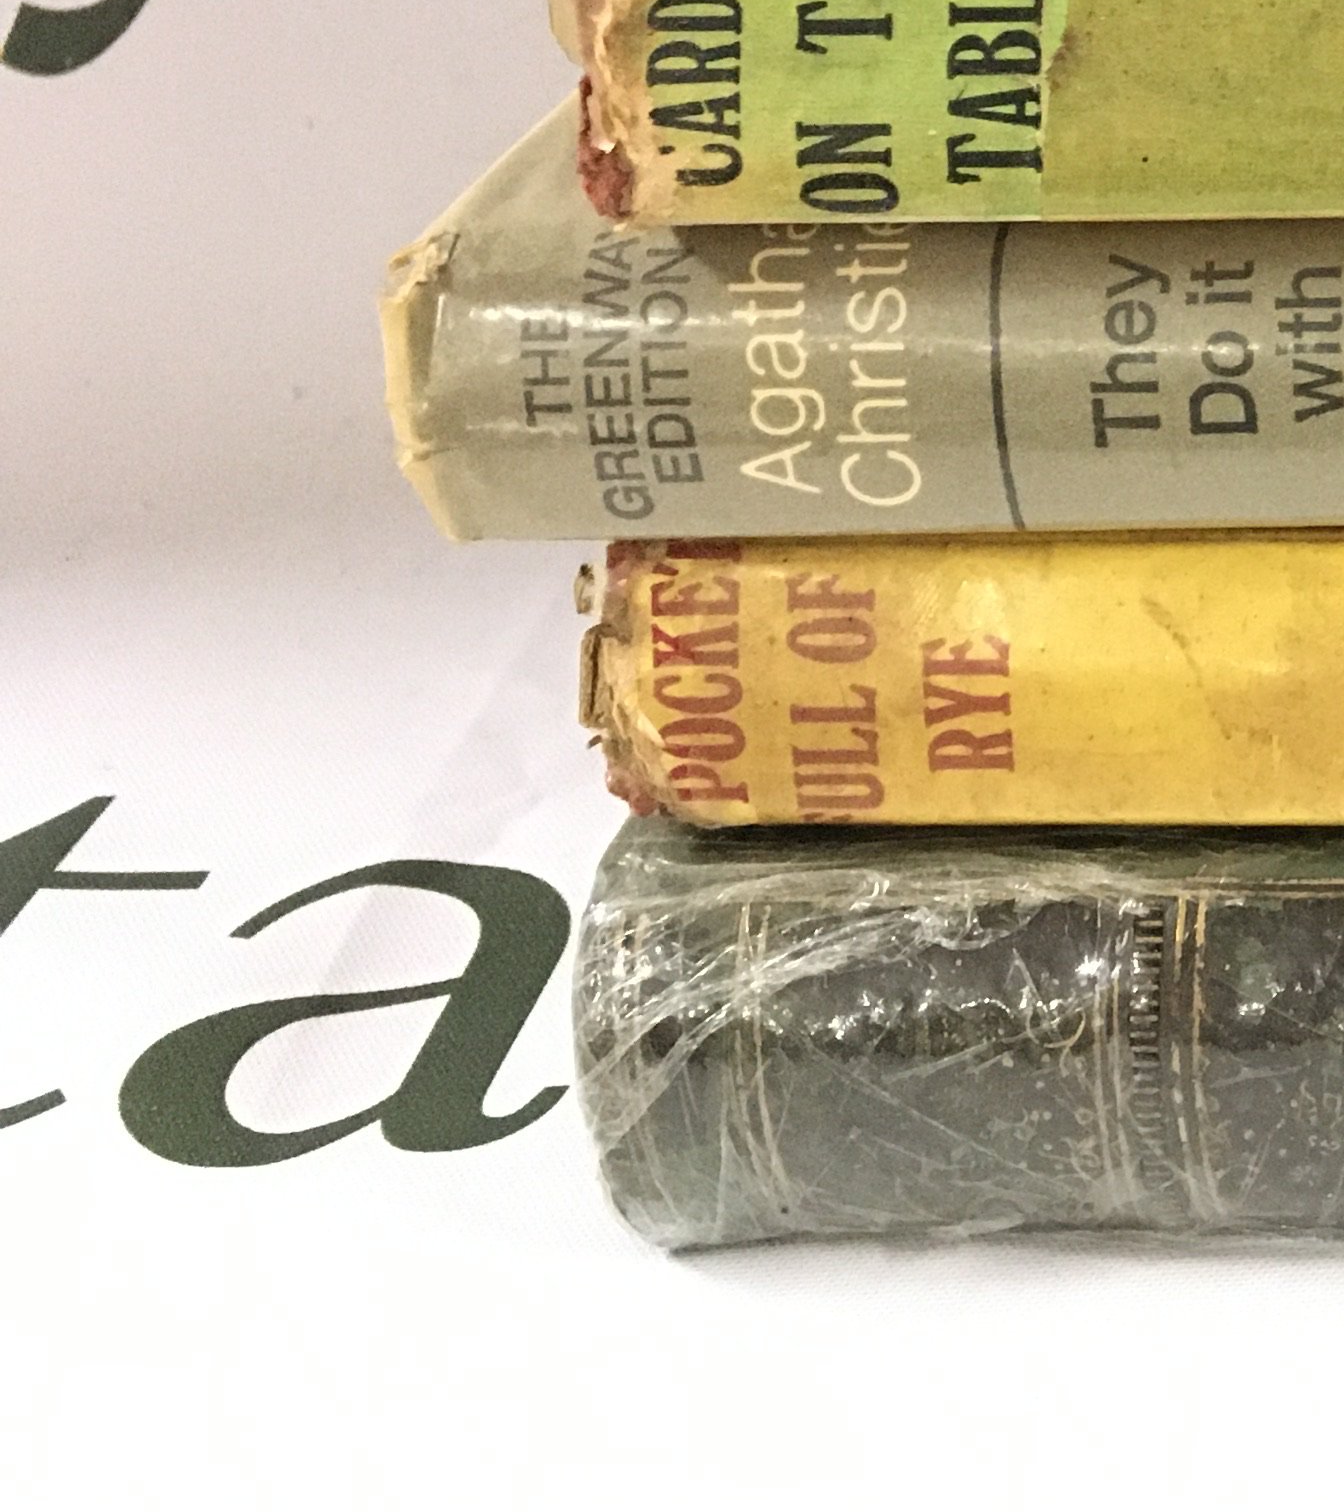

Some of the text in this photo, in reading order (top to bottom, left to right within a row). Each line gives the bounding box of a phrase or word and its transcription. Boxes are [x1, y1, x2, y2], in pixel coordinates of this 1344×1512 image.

[796, 121, 900, 214] ON
[520, 314, 574, 426] THE
[582, 232, 655, 520] GREENWA
[639, 247, 704, 484] EDITION
[1090, 254, 1171, 448] They
[1185, 259, 1258, 435] Do it
[1274, 265, 1344, 422] with
[786, 571, 885, 822] ULL OF
[921, 634, 1015, 773] RYE
